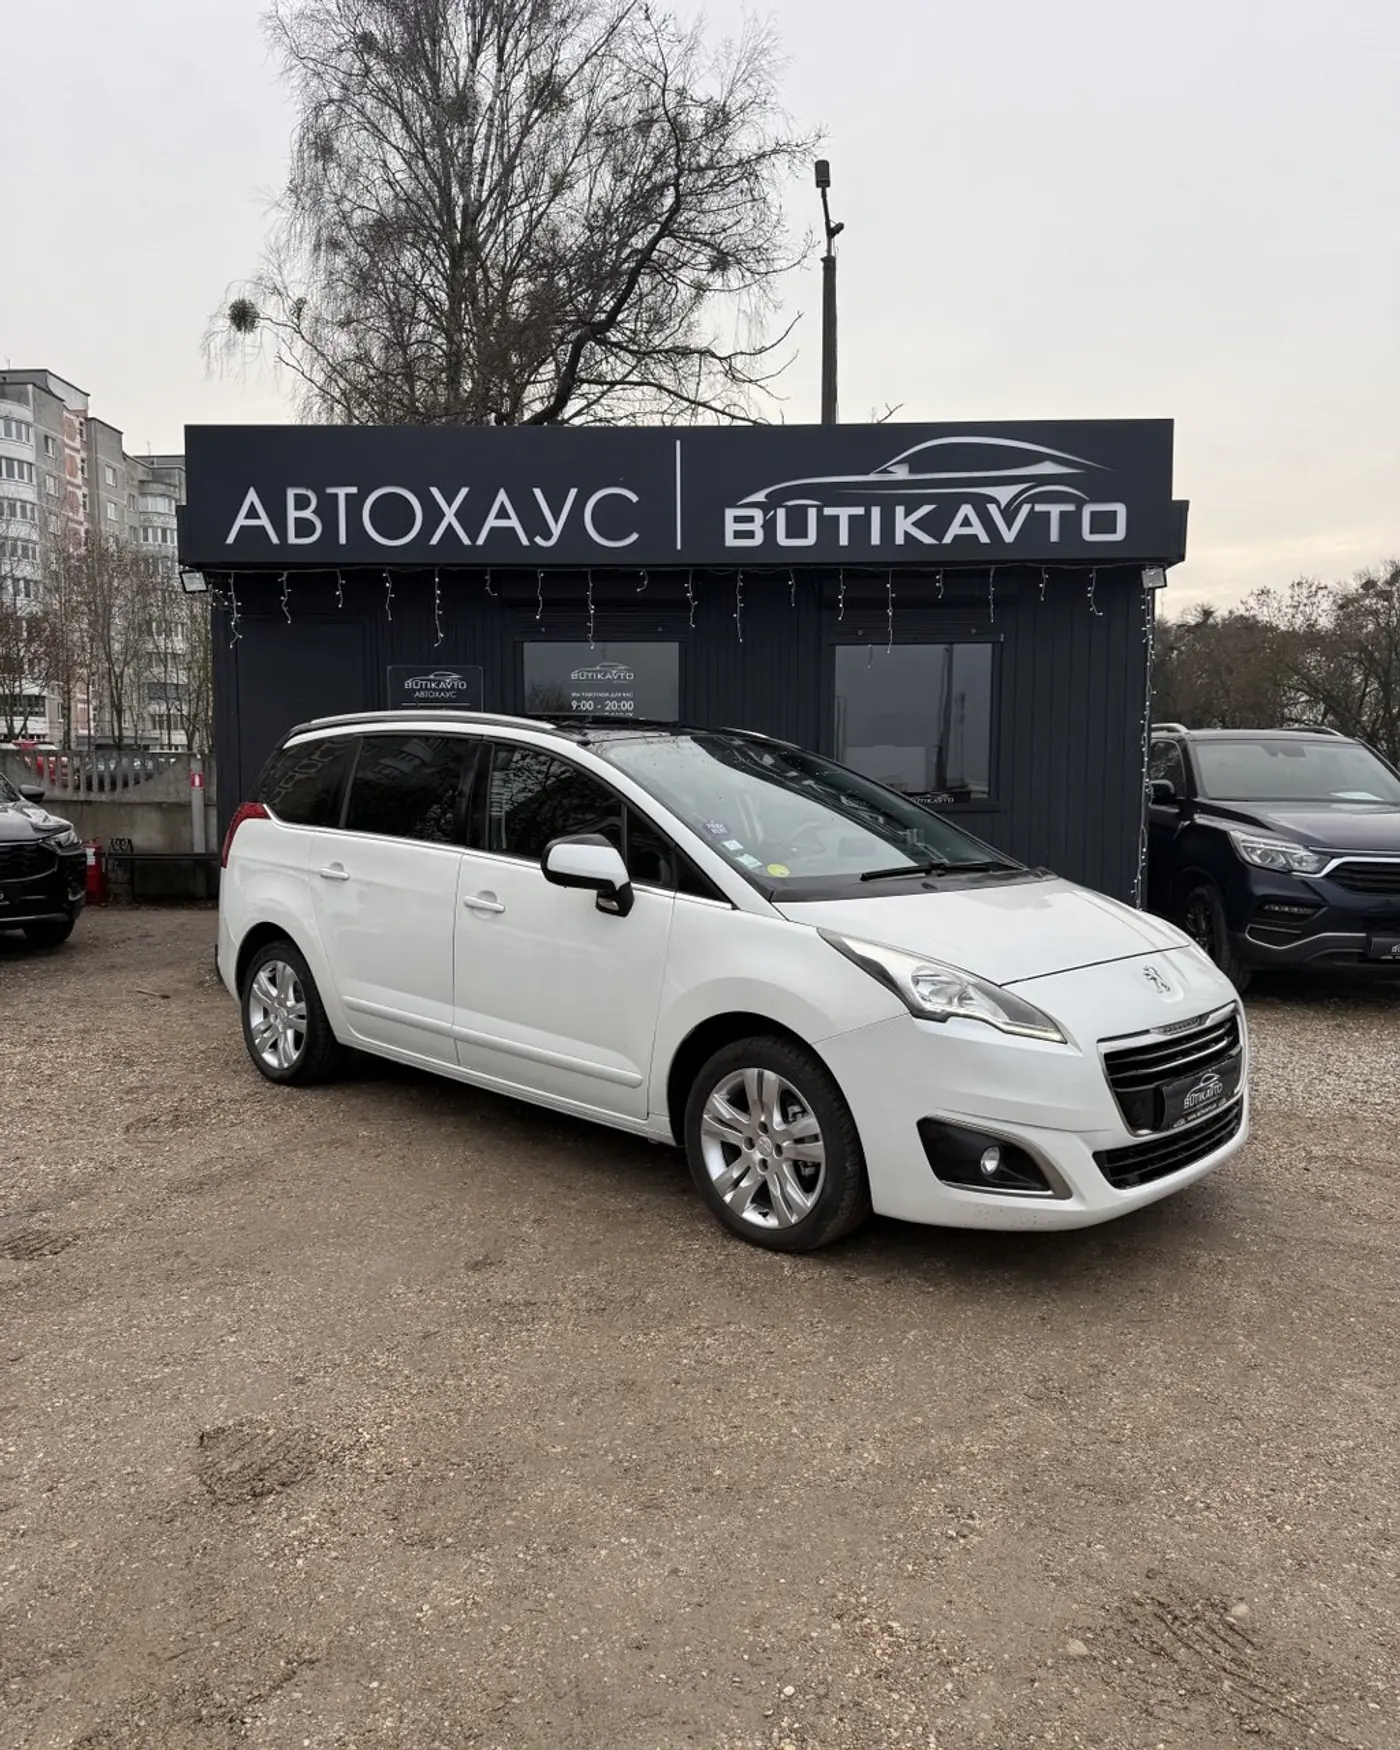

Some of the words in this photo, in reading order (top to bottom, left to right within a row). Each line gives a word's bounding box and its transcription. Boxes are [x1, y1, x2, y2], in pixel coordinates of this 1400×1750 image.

[224, 486, 640, 548] АВТОХАУС
[724, 502, 1127, 547] BUTIKAVTO
[571, 672, 635, 680] BUTIKAVTO
[404, 680, 467, 689] BUTIKAVTO
[414, 690, 457, 698] АВТОХАУС
[571, 700, 594, 711] 9:00
[604, 700, 635, 711] 20:00
